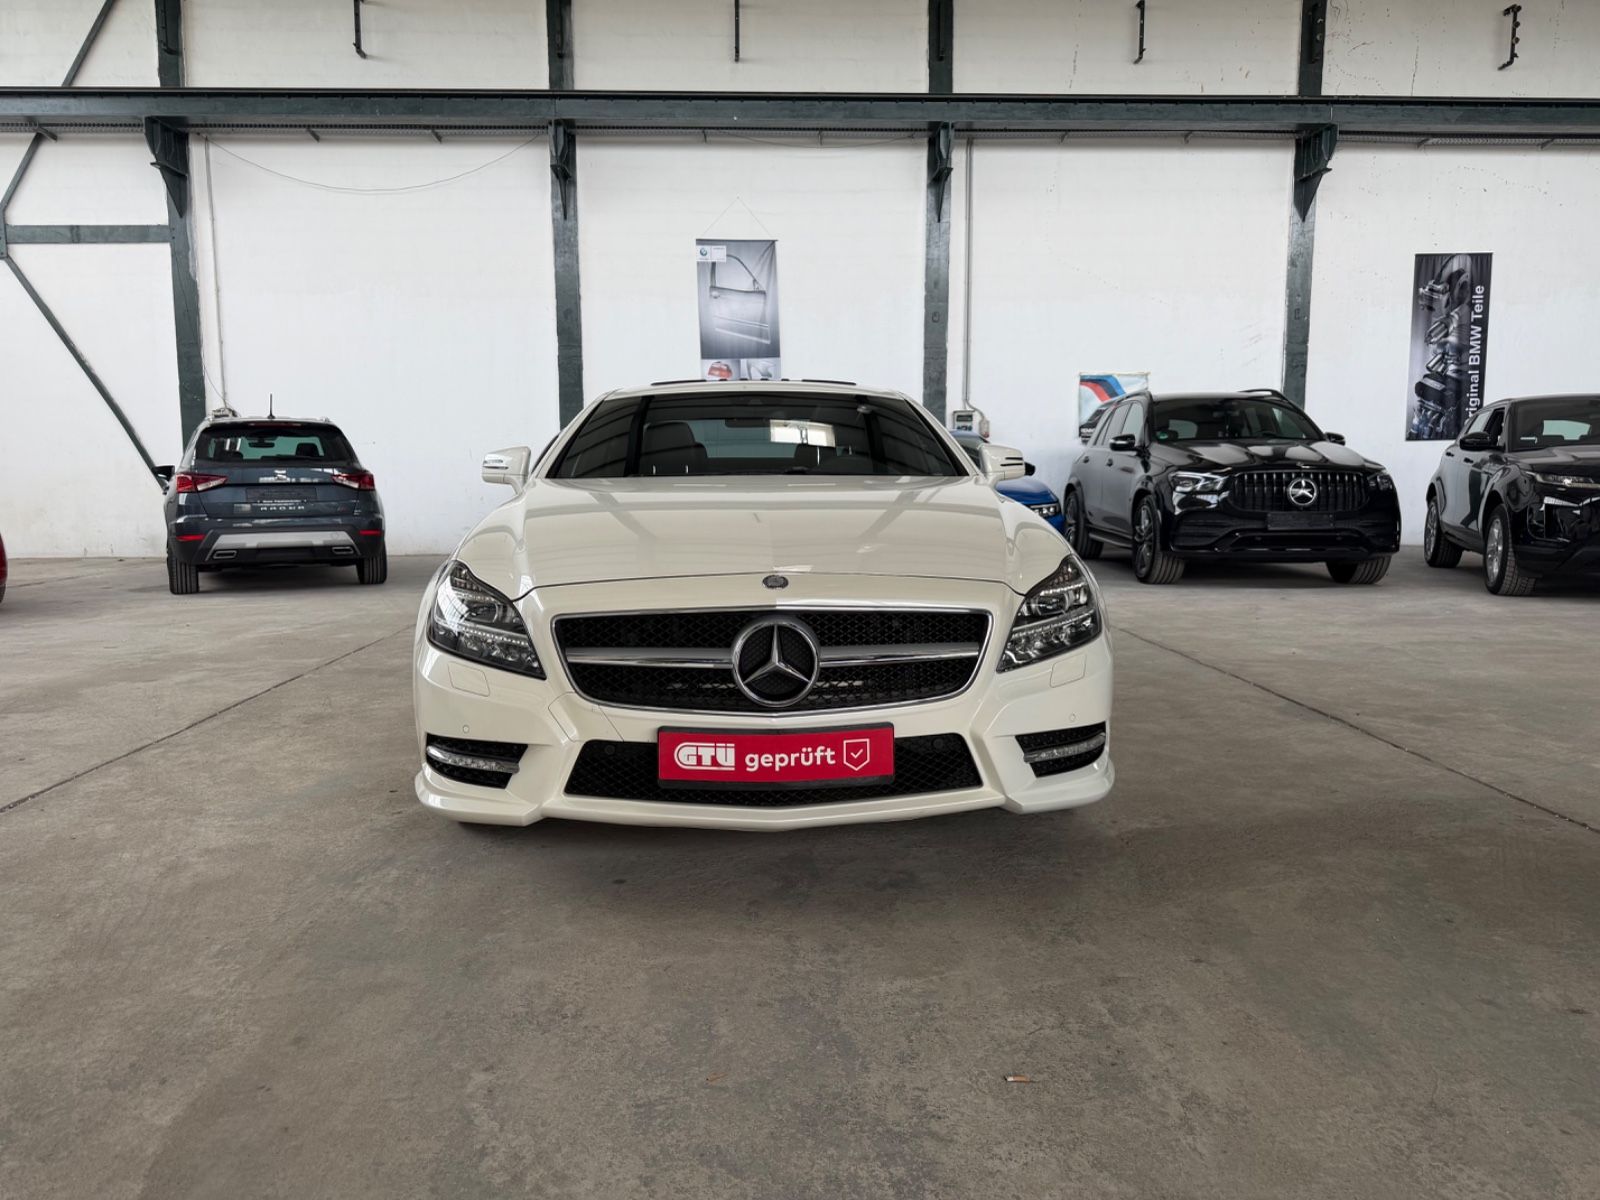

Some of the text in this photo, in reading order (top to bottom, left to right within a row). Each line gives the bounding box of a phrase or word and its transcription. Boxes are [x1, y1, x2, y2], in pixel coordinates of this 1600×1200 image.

[1464, 285, 1485, 423] riginal BMW Teile
[674, 742, 835, 771] GTÜ geprüft
